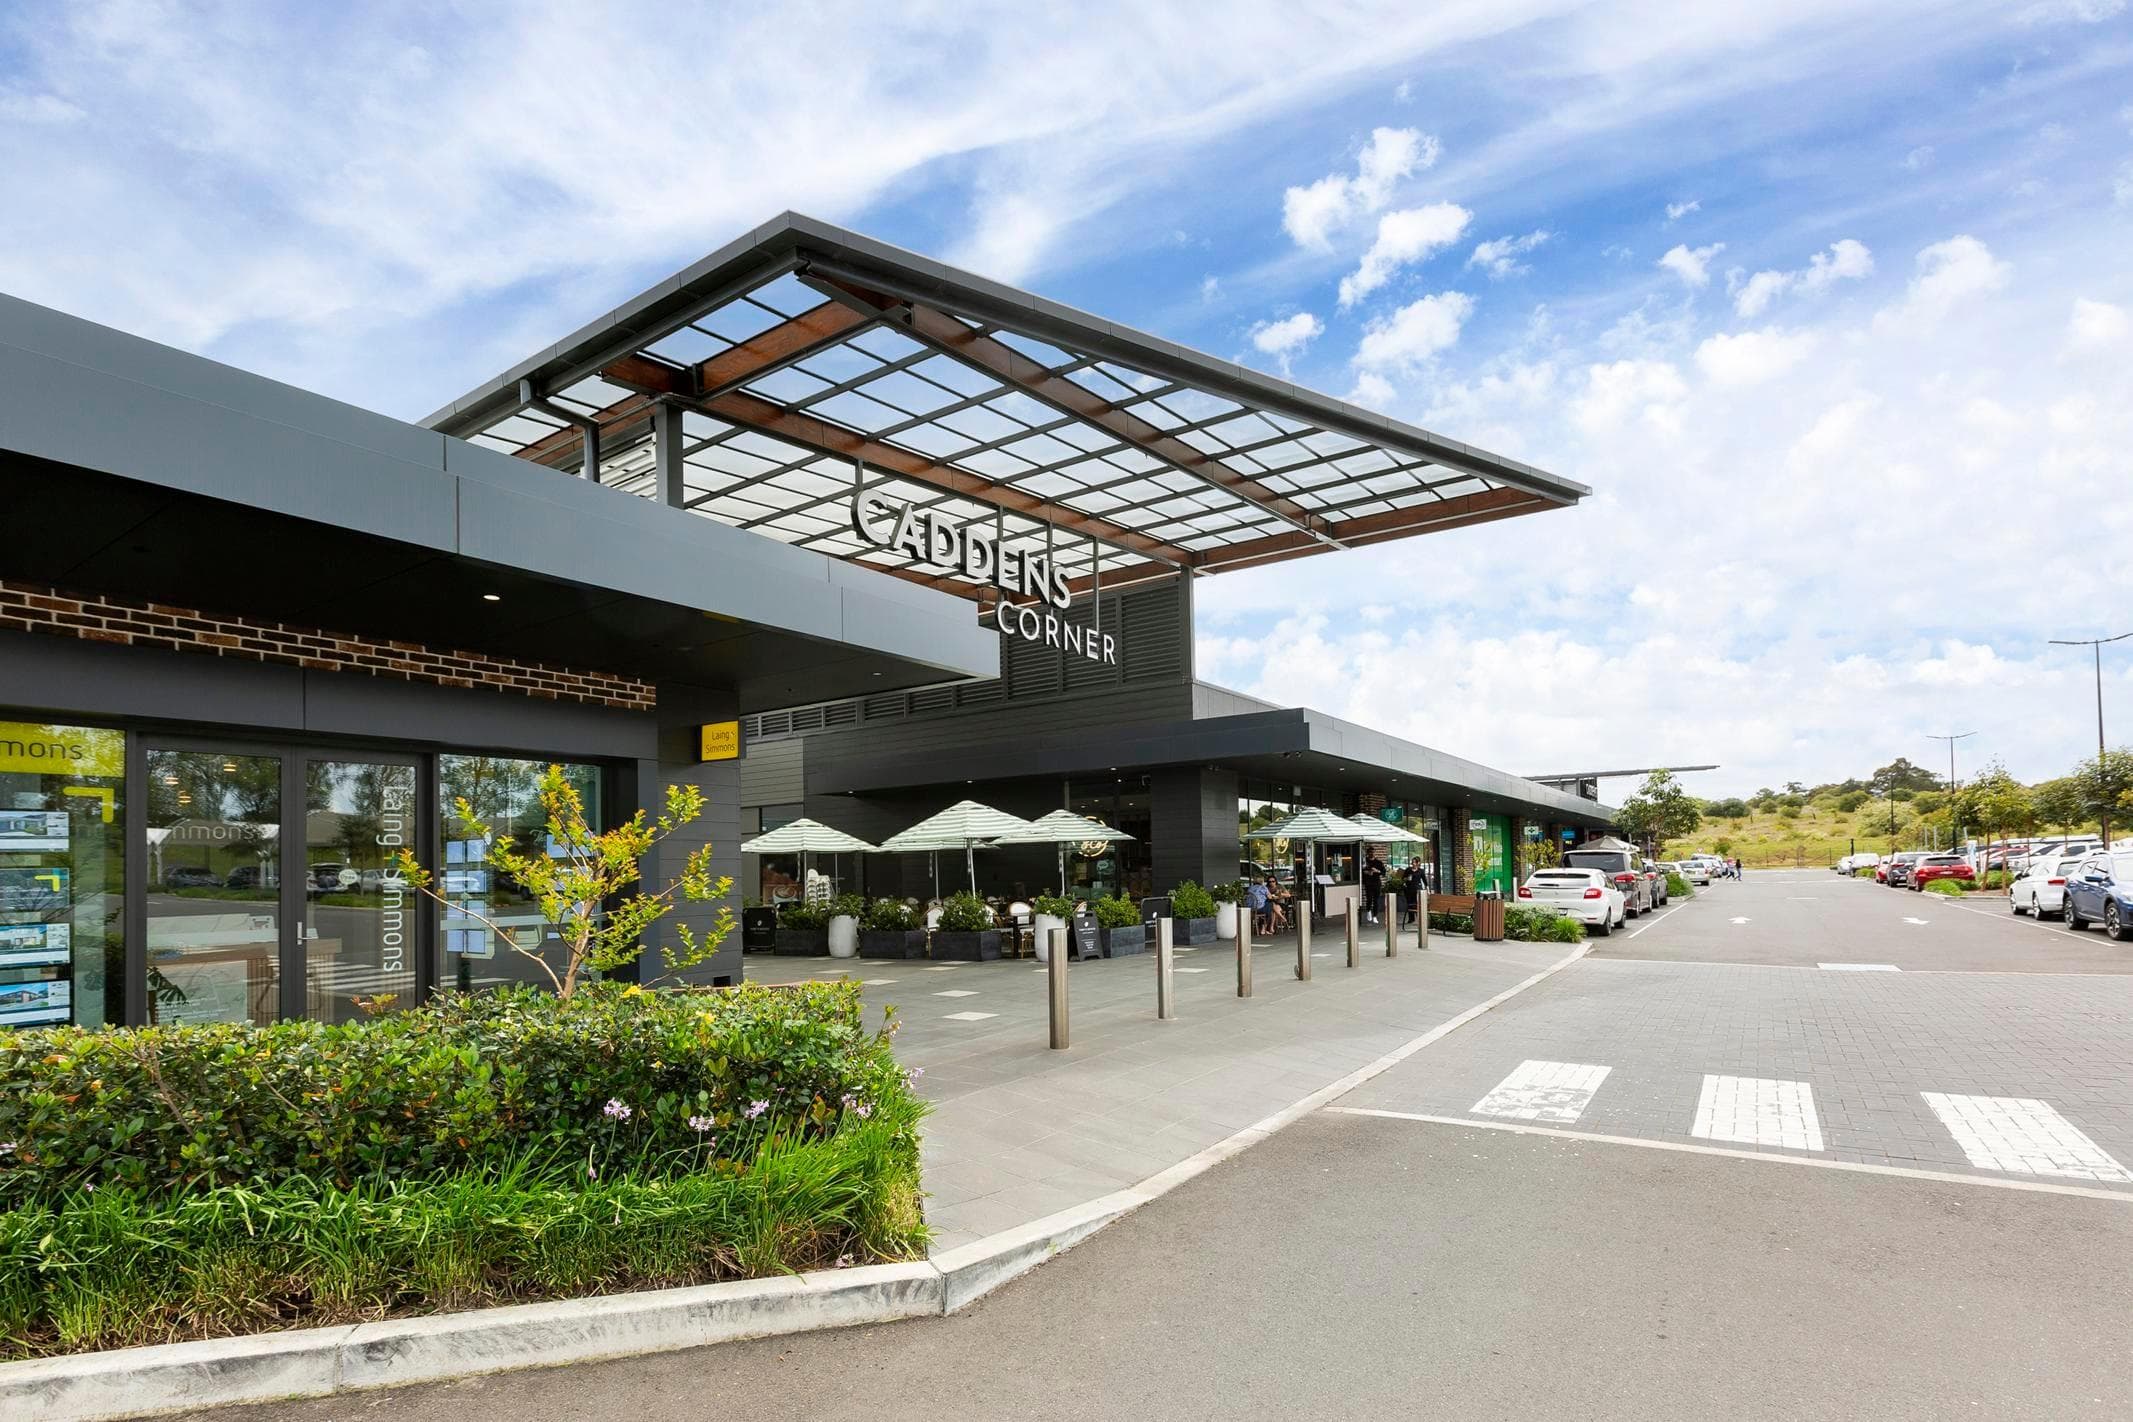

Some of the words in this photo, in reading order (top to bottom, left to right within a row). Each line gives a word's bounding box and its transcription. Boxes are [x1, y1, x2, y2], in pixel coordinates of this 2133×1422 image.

[851, 489, 1071, 609] CADDENS
[996, 601, 1116, 665] CORNER
[0, 740, 83, 760] mons
[705, 744, 735, 753] Simmons
[712, 730, 730, 741] Laing
[375, 786, 408, 846] Laing
[383, 868, 406, 973] Simmons
